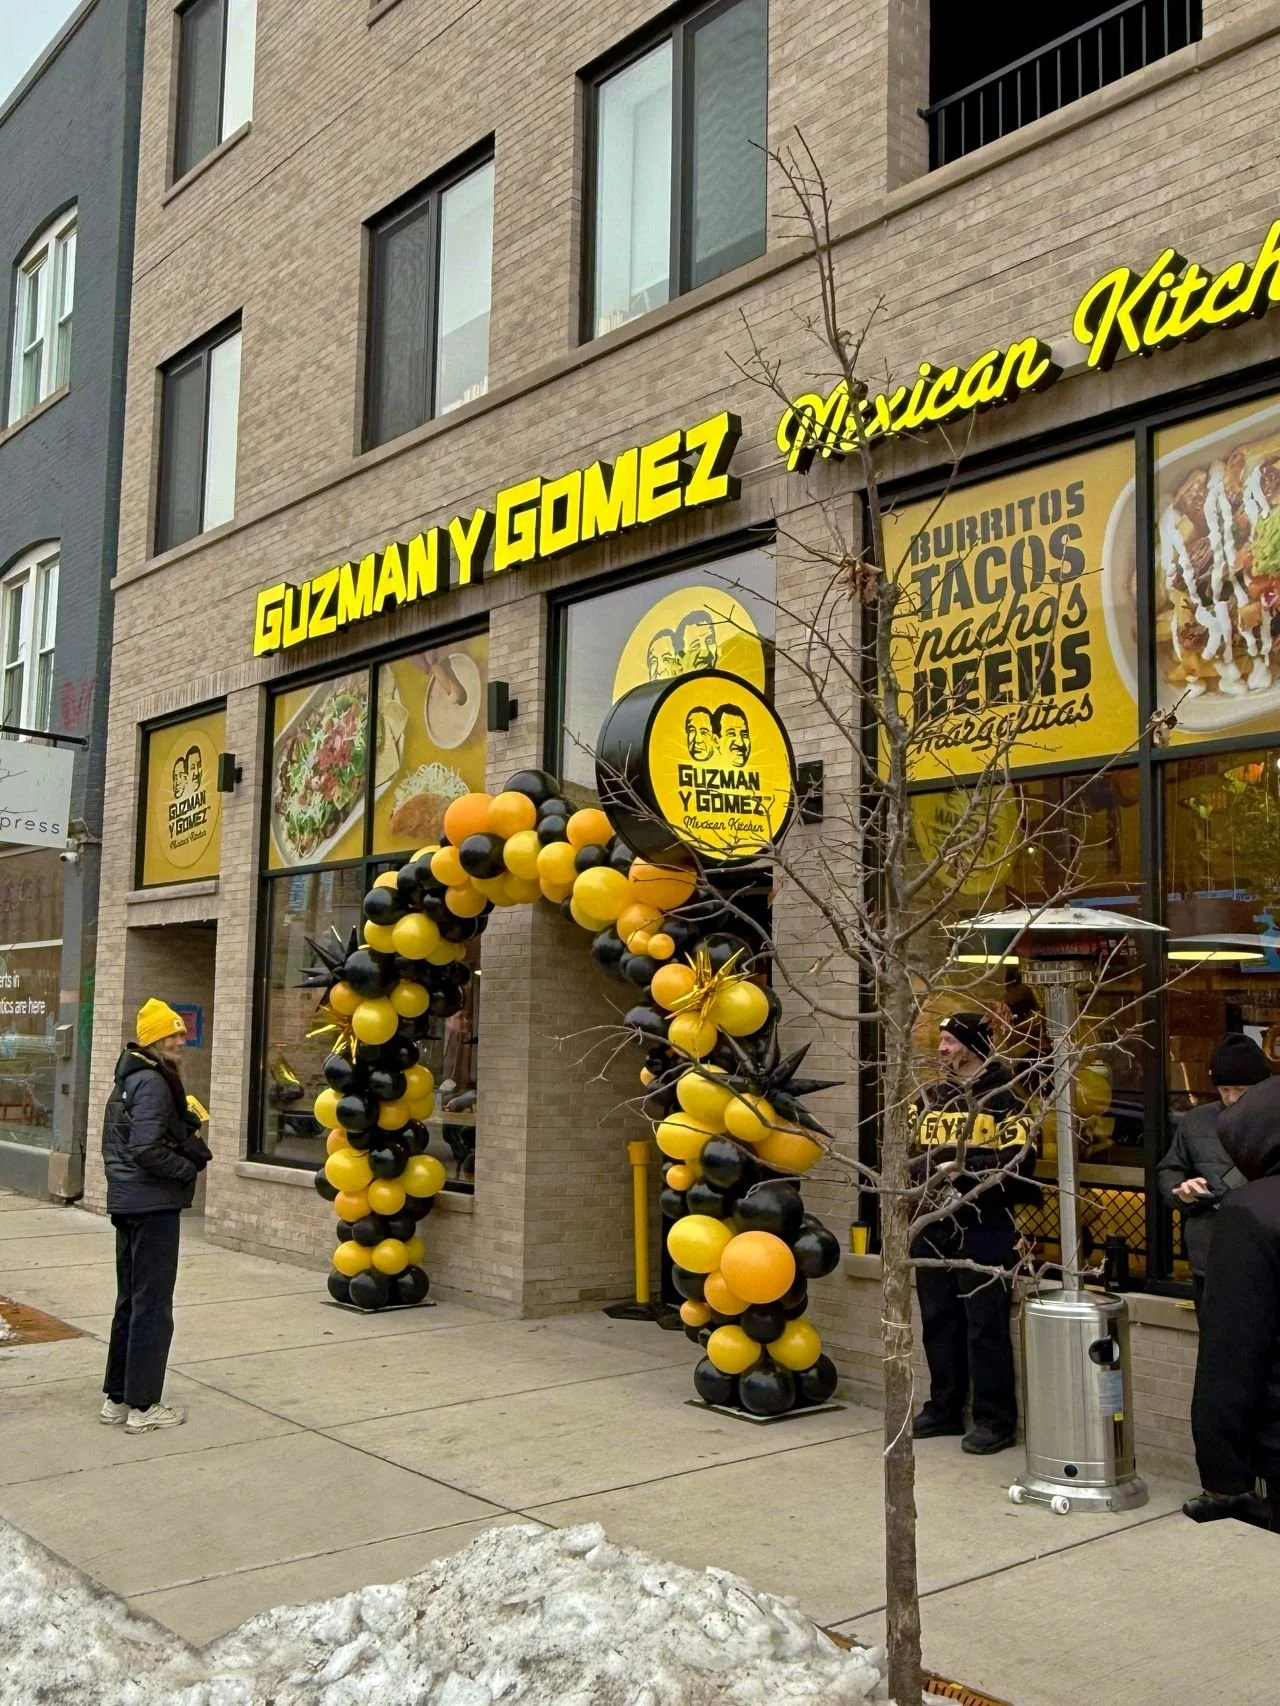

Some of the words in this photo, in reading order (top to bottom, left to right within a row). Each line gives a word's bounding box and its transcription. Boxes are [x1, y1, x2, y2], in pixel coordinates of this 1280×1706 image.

[253, 526, 441, 658] GUZMAN
[448, 507, 487, 586] Y
[493, 411, 730, 573] GOMEZ
[910, 480, 1085, 567] BURRITOS
[911, 523, 1086, 622] TACOS
[914, 583, 1087, 668] nachos
[913, 630, 1092, 728] BEERS
[168, 790, 206, 822] GUZMAN
[678, 764, 761, 791] GUZMAN
[678, 790, 692, 812] Y
[696, 789, 764, 816] GOMEZ
[168, 822, 175, 839] Y
[175, 808, 208, 836] GOMEZ
[683, 815, 727, 830] Mexican
[728, 817, 765, 833] Kitchen
